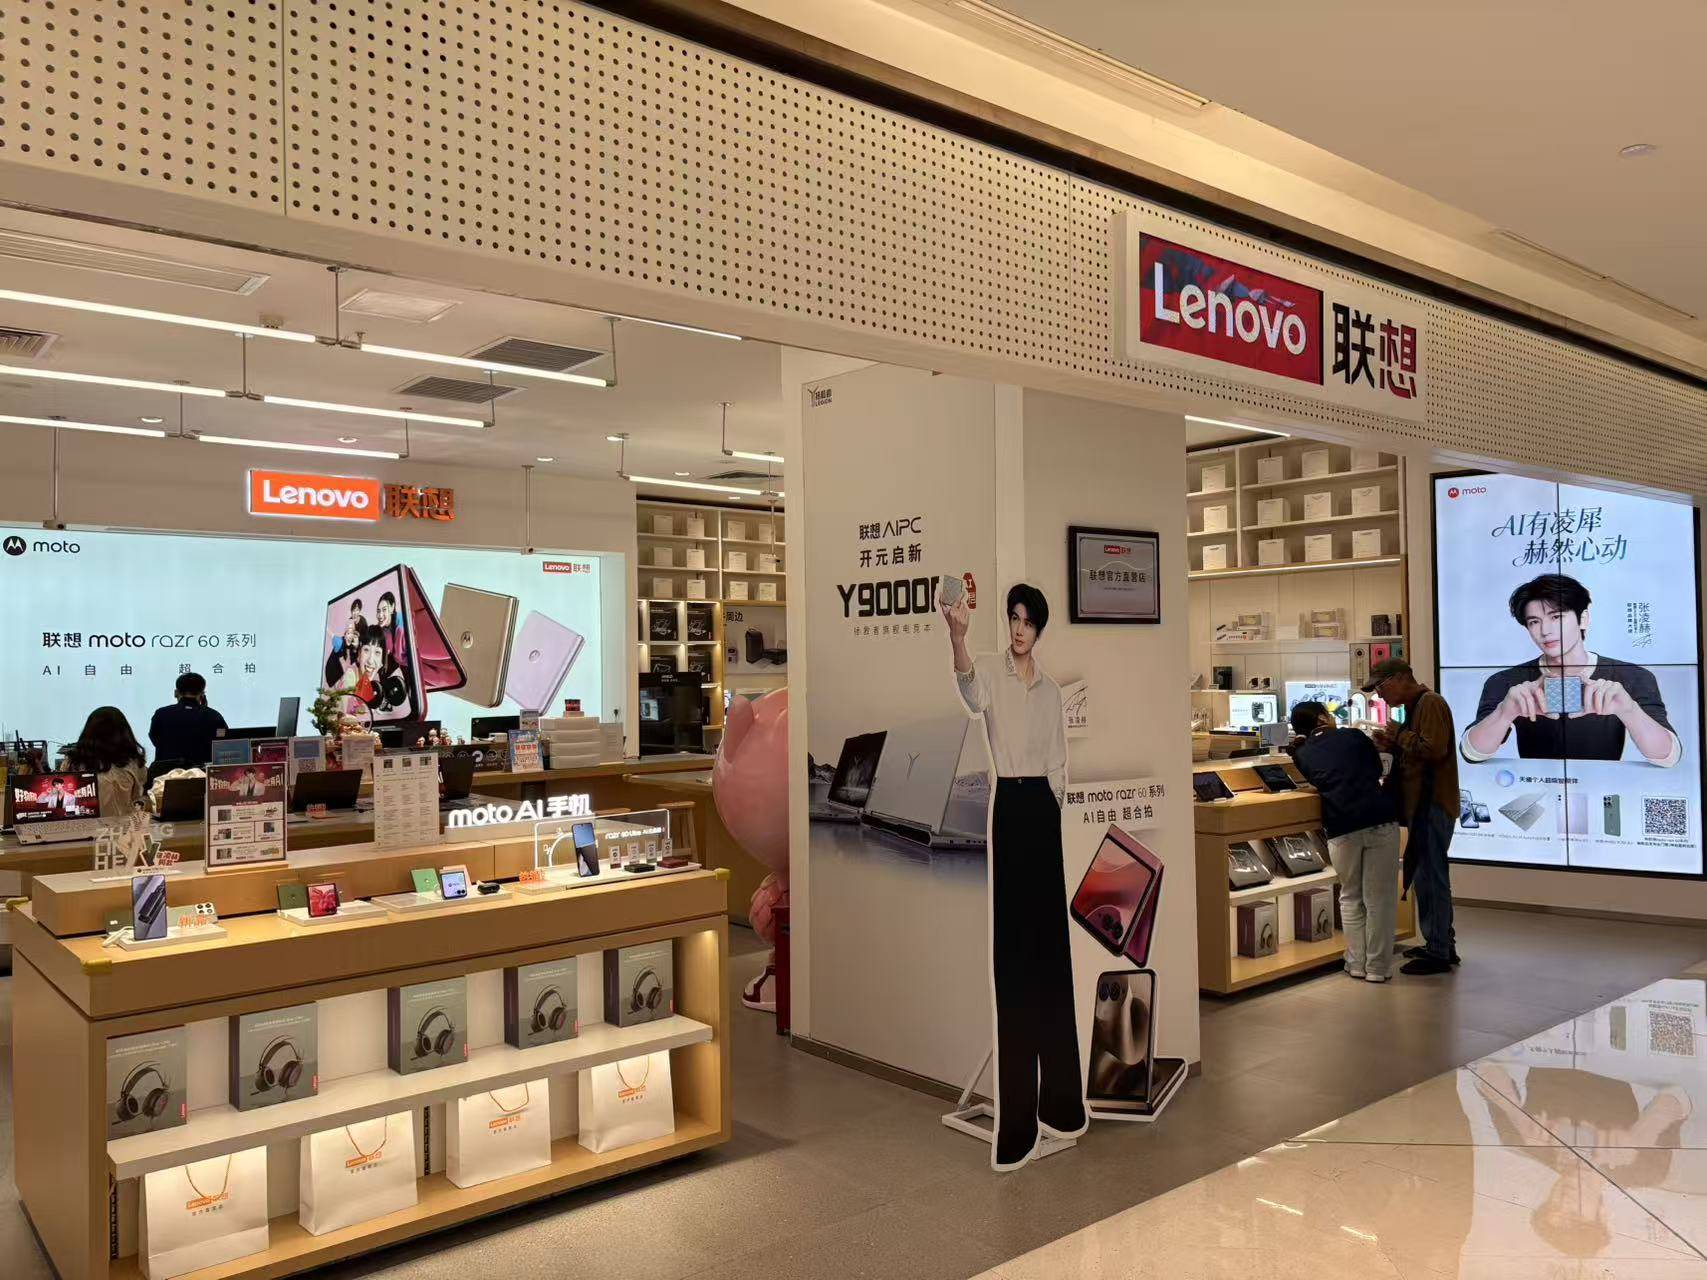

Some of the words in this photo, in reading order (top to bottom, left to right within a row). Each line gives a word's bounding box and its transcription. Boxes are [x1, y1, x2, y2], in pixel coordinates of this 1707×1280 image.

[1153, 261, 1308, 357] Lenovo
[1332, 301, 1418, 400] 联想
[263, 479, 369, 509] Lenovo
[383, 482, 456, 522] 联想
[1461, 486, 1487, 495] moto
[1491, 506, 1602, 539] AI有凌犀
[33, 539, 81, 554] moto
[859, 543, 922, 568] 开元启新
[1512, 534, 1627, 568] 赫然心动
[544, 563, 570, 571] Lenovo
[1089, 569, 1148, 583] 联想官方直营店
[42, 632, 82, 649] 联想
[89, 632, 146, 648] moto
[151, 633, 193, 648] razr
[198, 634, 220, 648] 60
[225, 633, 256, 648] 系列
[1067, 792, 1085, 805] 联想
[1088, 789, 1113, 802] moto
[1115, 788, 1136, 800] razr
[1137, 788, 1147, 798] 60
[1149, 784, 1165, 798] 系列
[448, 803, 513, 828] moto
[514, 799, 544, 821] AI
[547, 793, 593, 818] 手机
[1123, 804, 1153, 820] 超合拍
